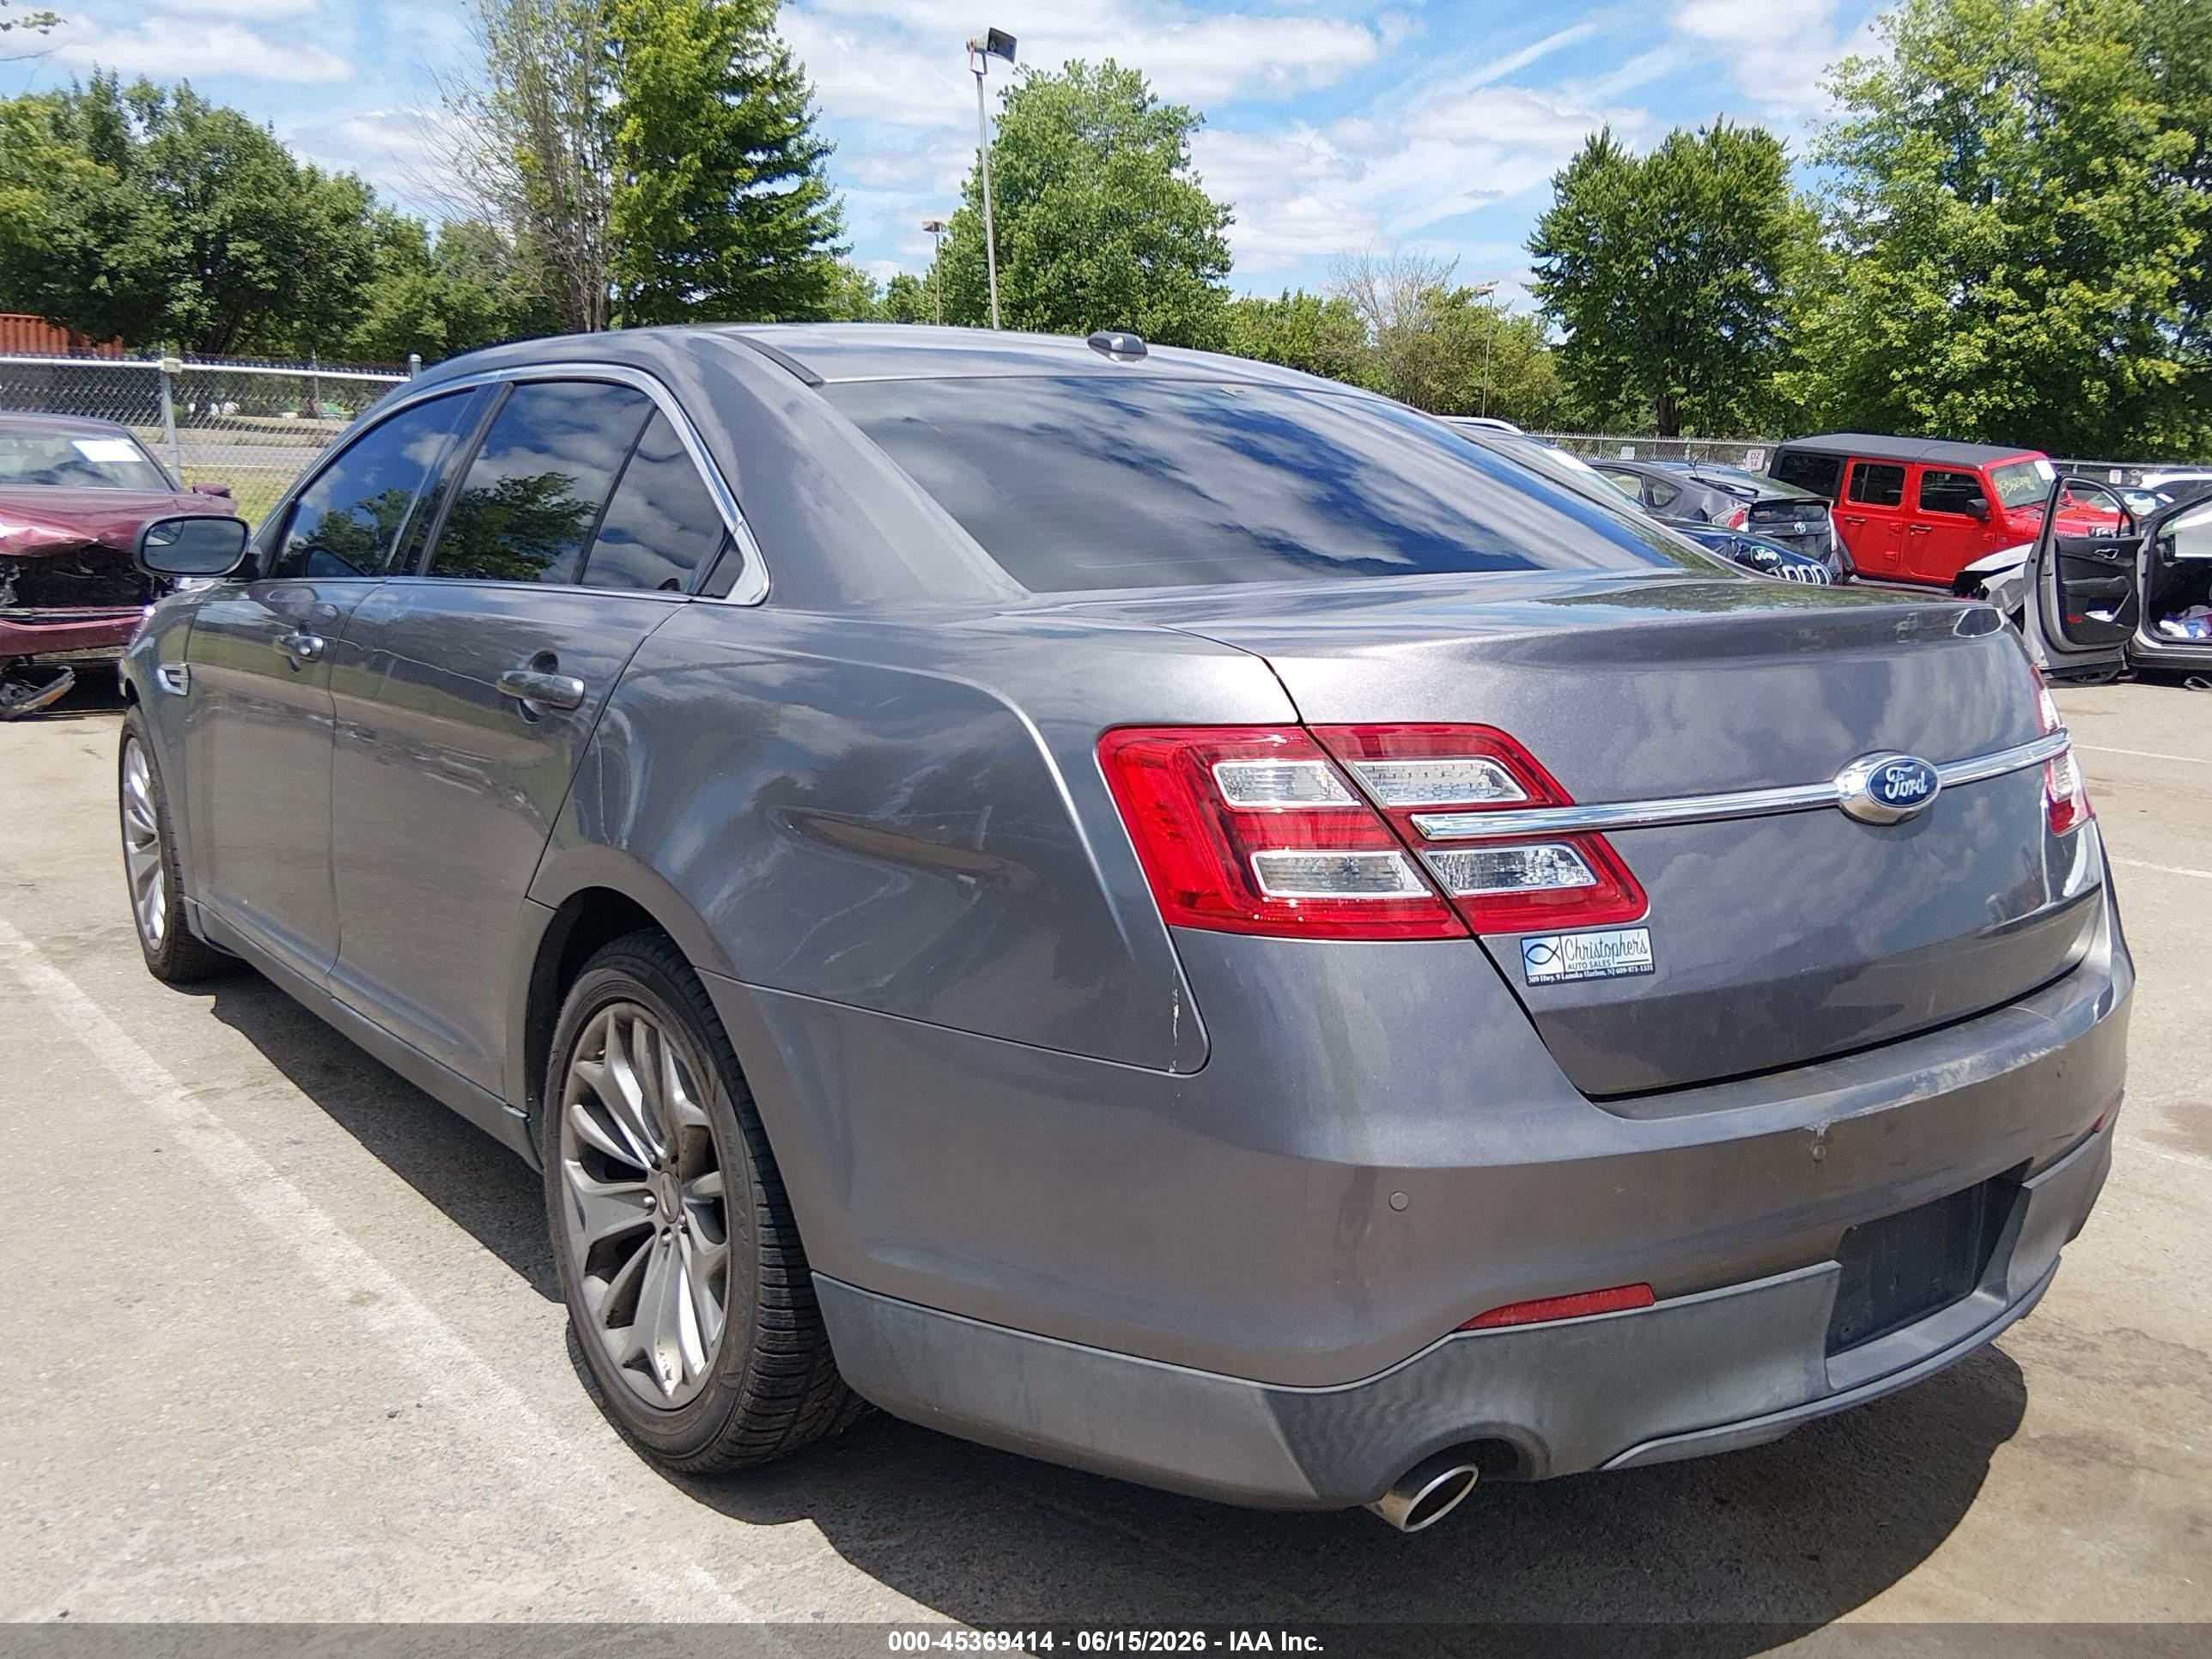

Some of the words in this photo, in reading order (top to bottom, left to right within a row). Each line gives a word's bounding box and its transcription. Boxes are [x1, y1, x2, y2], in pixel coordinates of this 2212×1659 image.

[1885, 766, 1928, 799] Ford
[1565, 931, 1649, 965] Christopher's
[1567, 962, 1588, 970] AUTO
[1589, 959, 1612, 969] SALES
